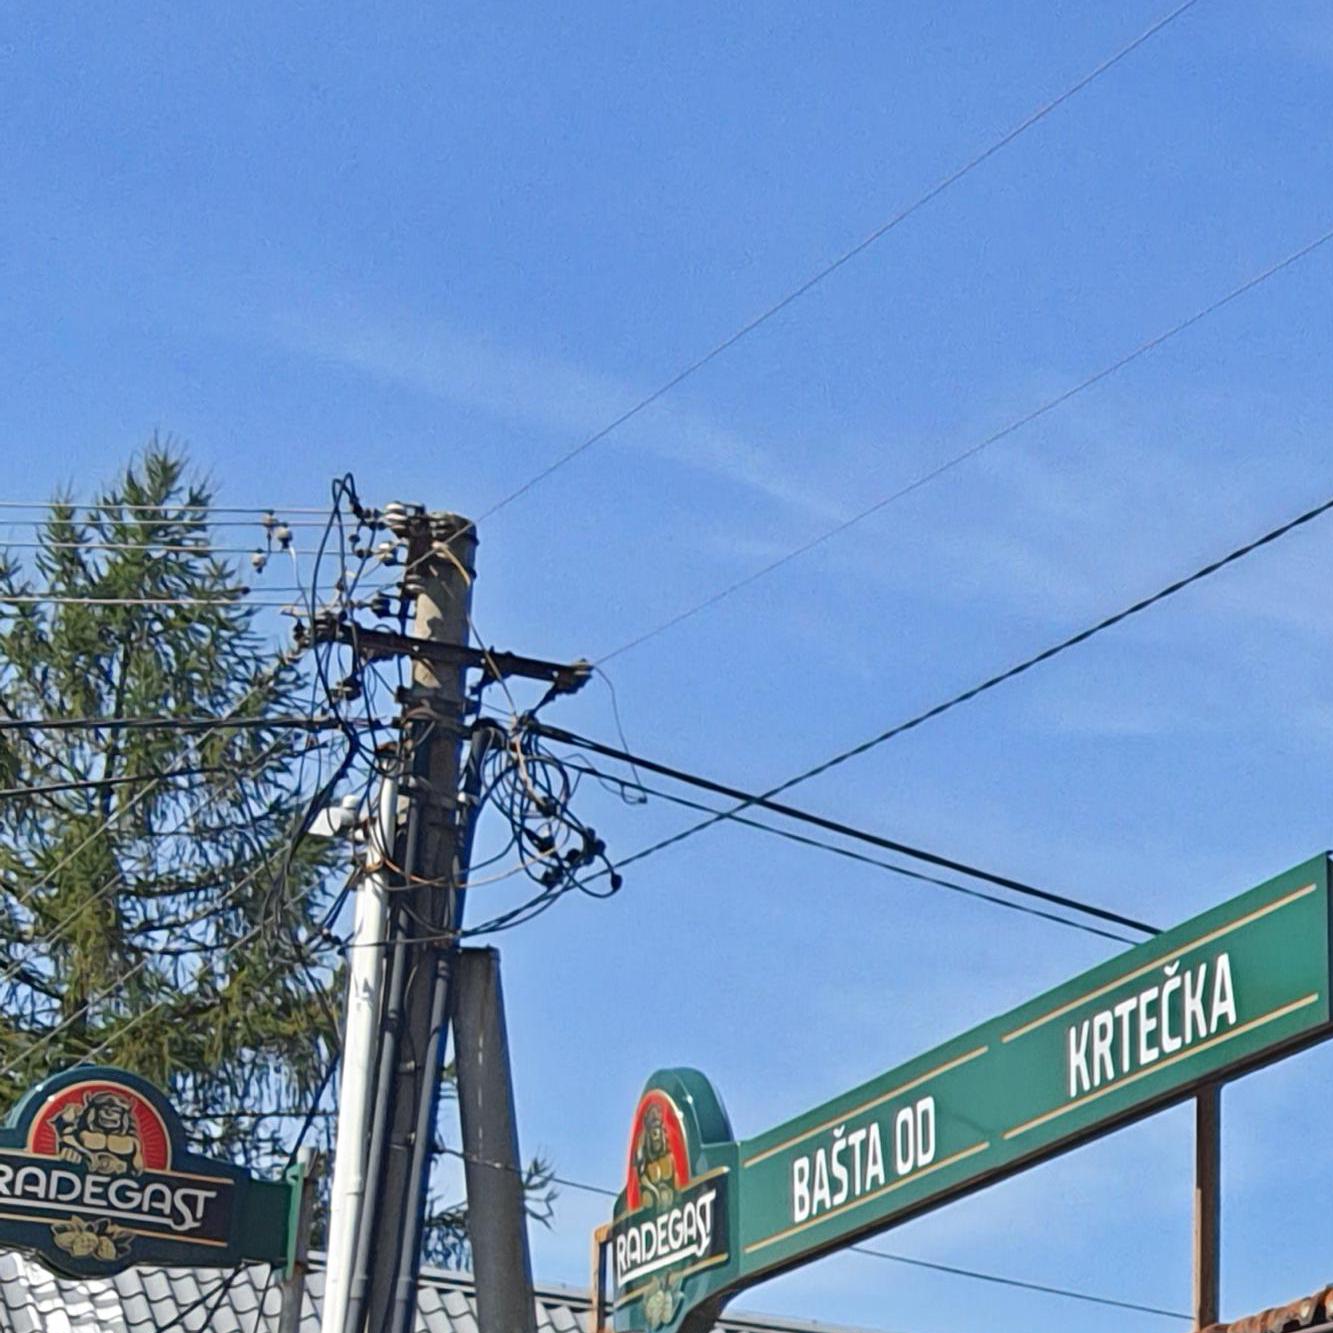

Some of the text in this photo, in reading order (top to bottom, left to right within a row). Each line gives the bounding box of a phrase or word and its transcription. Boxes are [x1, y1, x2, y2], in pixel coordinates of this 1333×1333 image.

[793, 952, 1238, 1223] BAŠTA OD KRTEČKA
[616, 1188, 717, 1288] RADEGAST
